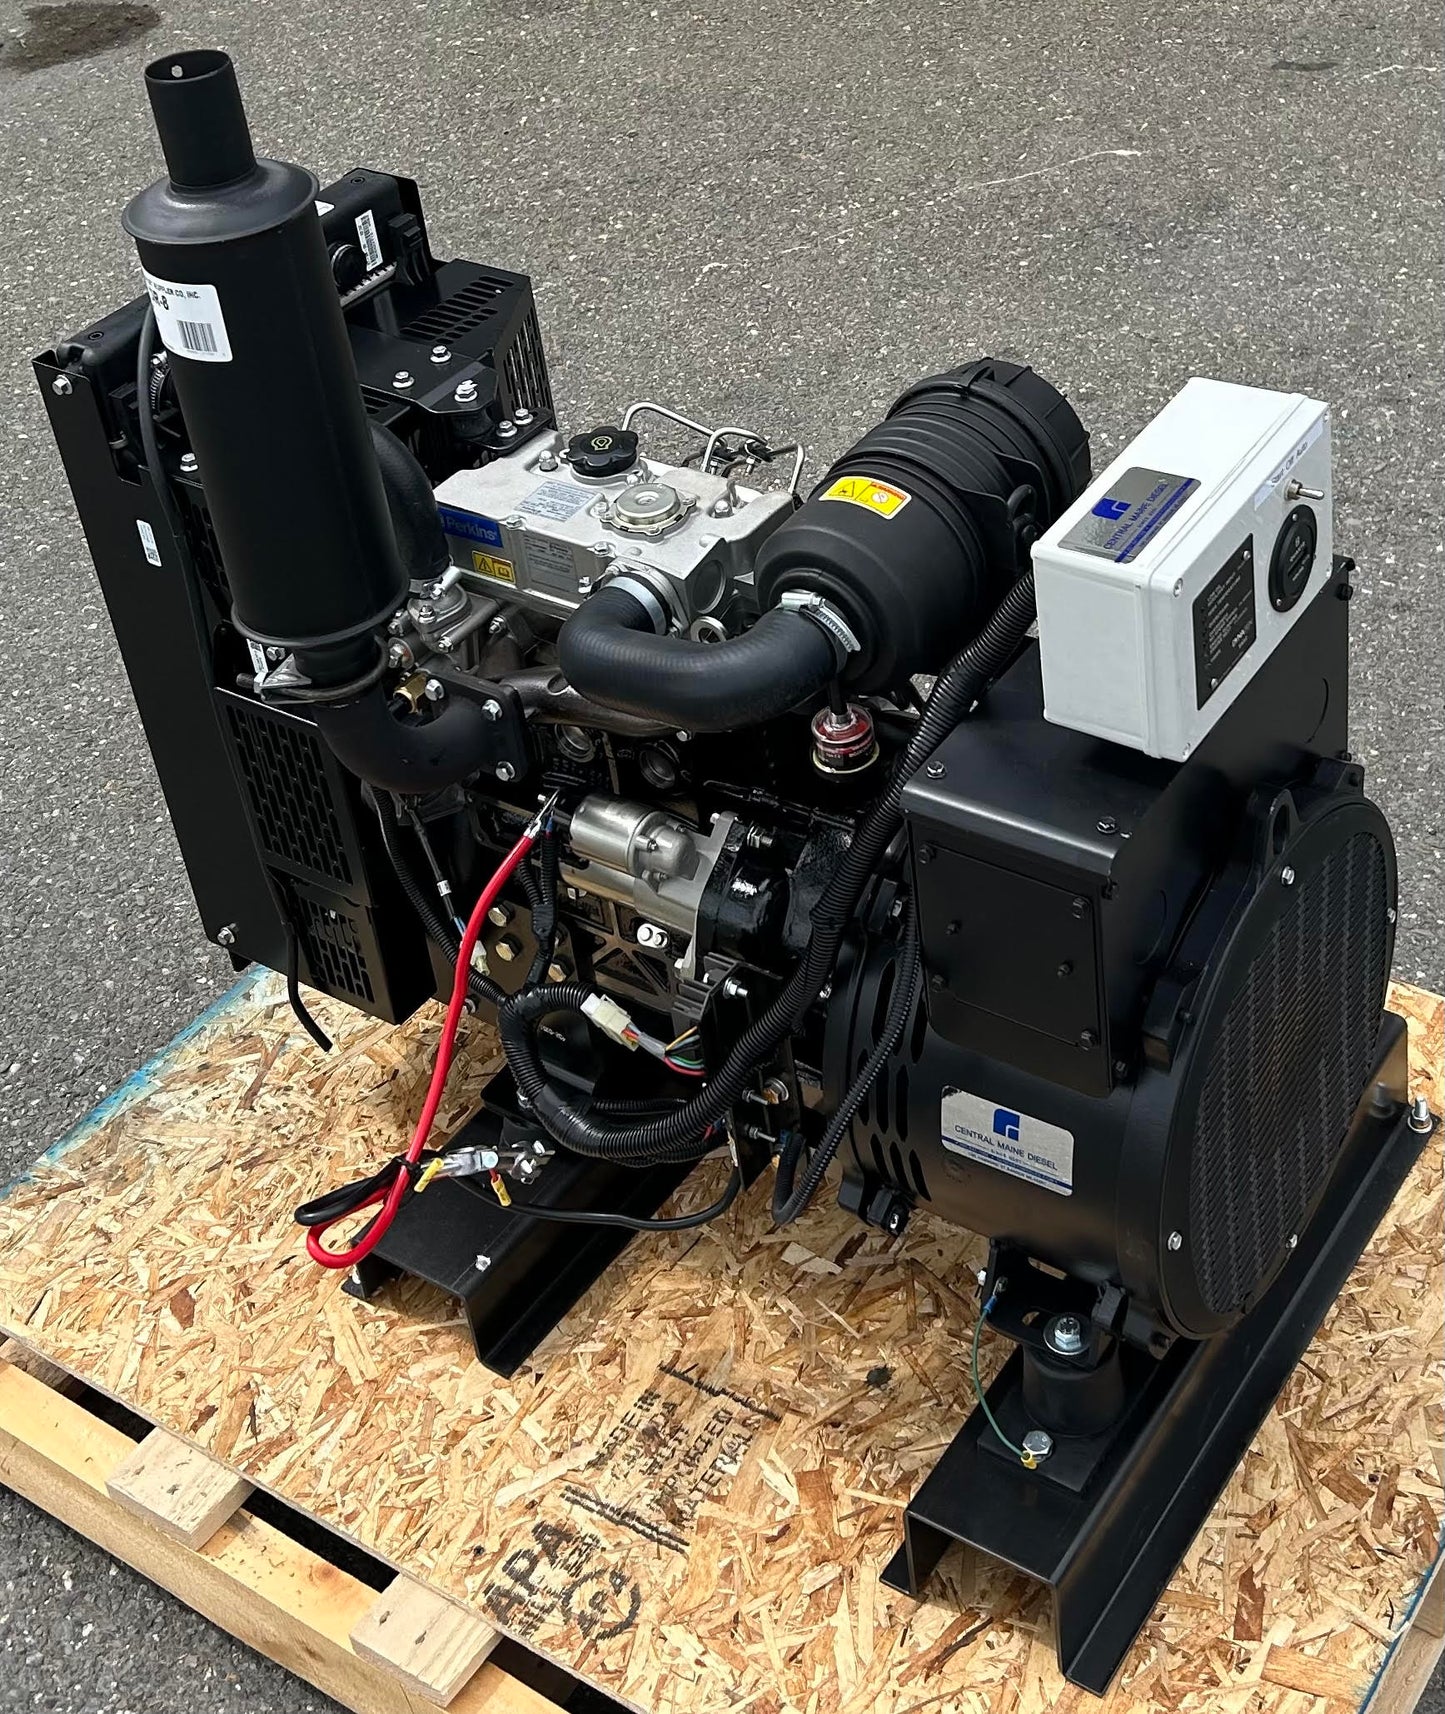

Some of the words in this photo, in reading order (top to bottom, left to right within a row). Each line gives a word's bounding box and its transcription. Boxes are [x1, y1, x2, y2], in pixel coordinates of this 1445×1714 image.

[446, 516, 497, 541] Perkins
[1103, 519, 1132, 550] CENTRAL
[1130, 502, 1150, 523] MAINE
[1146, 483, 1169, 503] DIESEL
[954, 1124, 995, 1147] CENTRAL
[997, 1140, 1024, 1158] MAINE
[1027, 1153, 1058, 1171] DIESEL
[482, 1519, 574, 1626] APA
